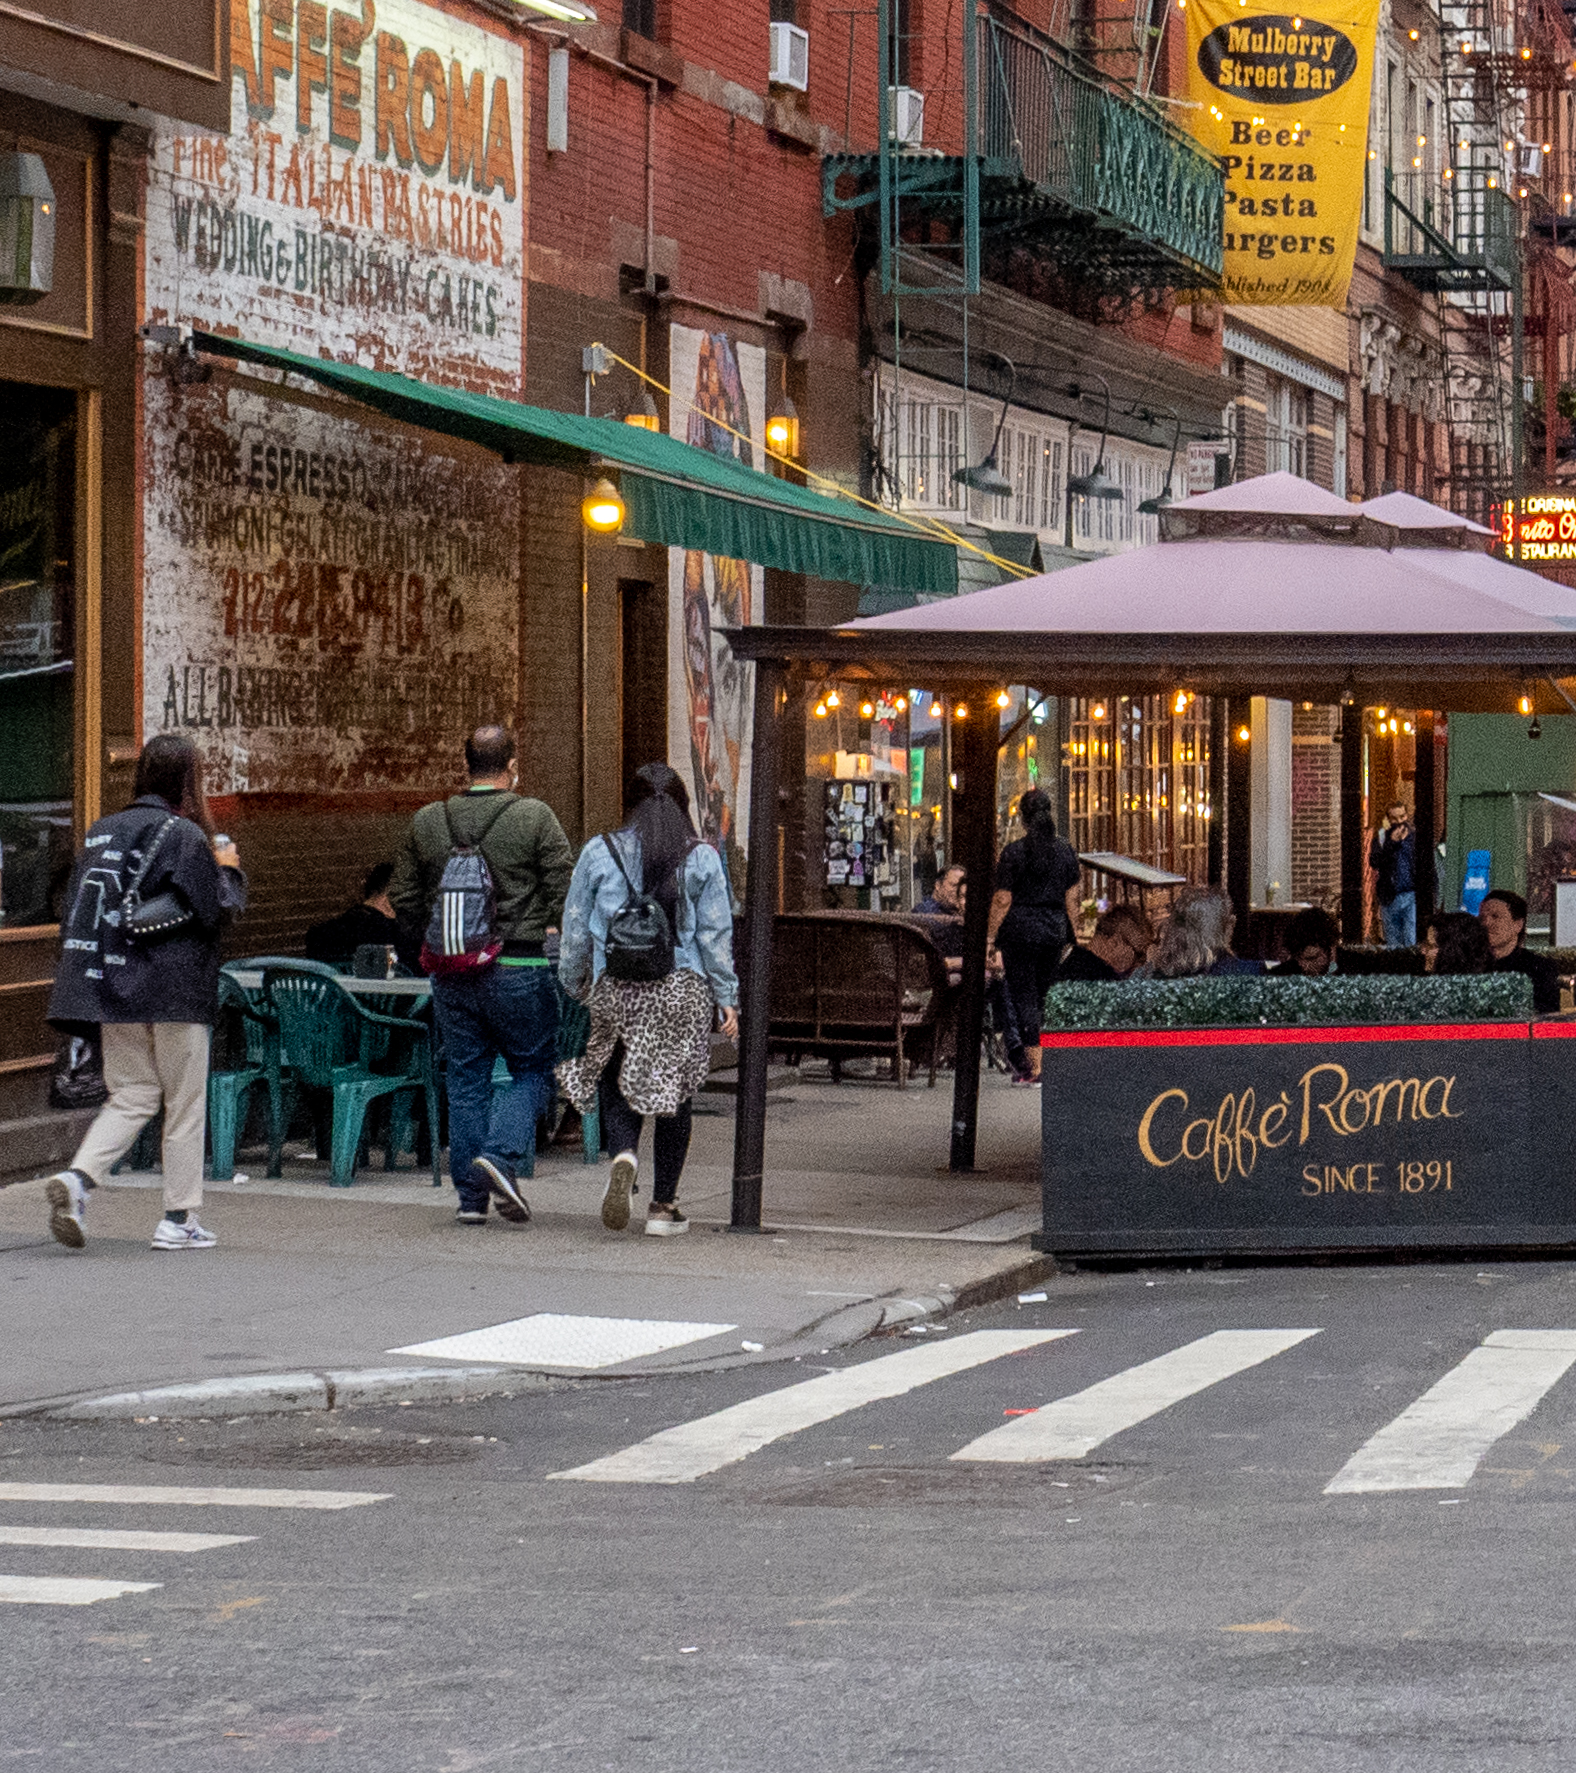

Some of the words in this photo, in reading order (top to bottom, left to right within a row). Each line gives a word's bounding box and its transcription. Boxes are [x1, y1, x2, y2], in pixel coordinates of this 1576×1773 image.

[1227, 25, 1337, 64] Mulberry
[1218, 59, 1288, 89] Street
[1293, 61, 1337, 90] Bar
[375, 30, 516, 202] ROMA
[1230, 120, 1313, 148] Beer
[1221, 154, 1318, 183] Pizza
[172, 190, 274, 282] WEDDING
[381, 168, 503, 267] PASTRIES
[1221, 231, 1337, 260] urgers
[163, 664, 214, 729] ALL
[1298, 1062, 1465, 1145] Roma
[1301, 1162, 1386, 1197] SINCE
[1397, 1159, 1453, 1194] 1891
